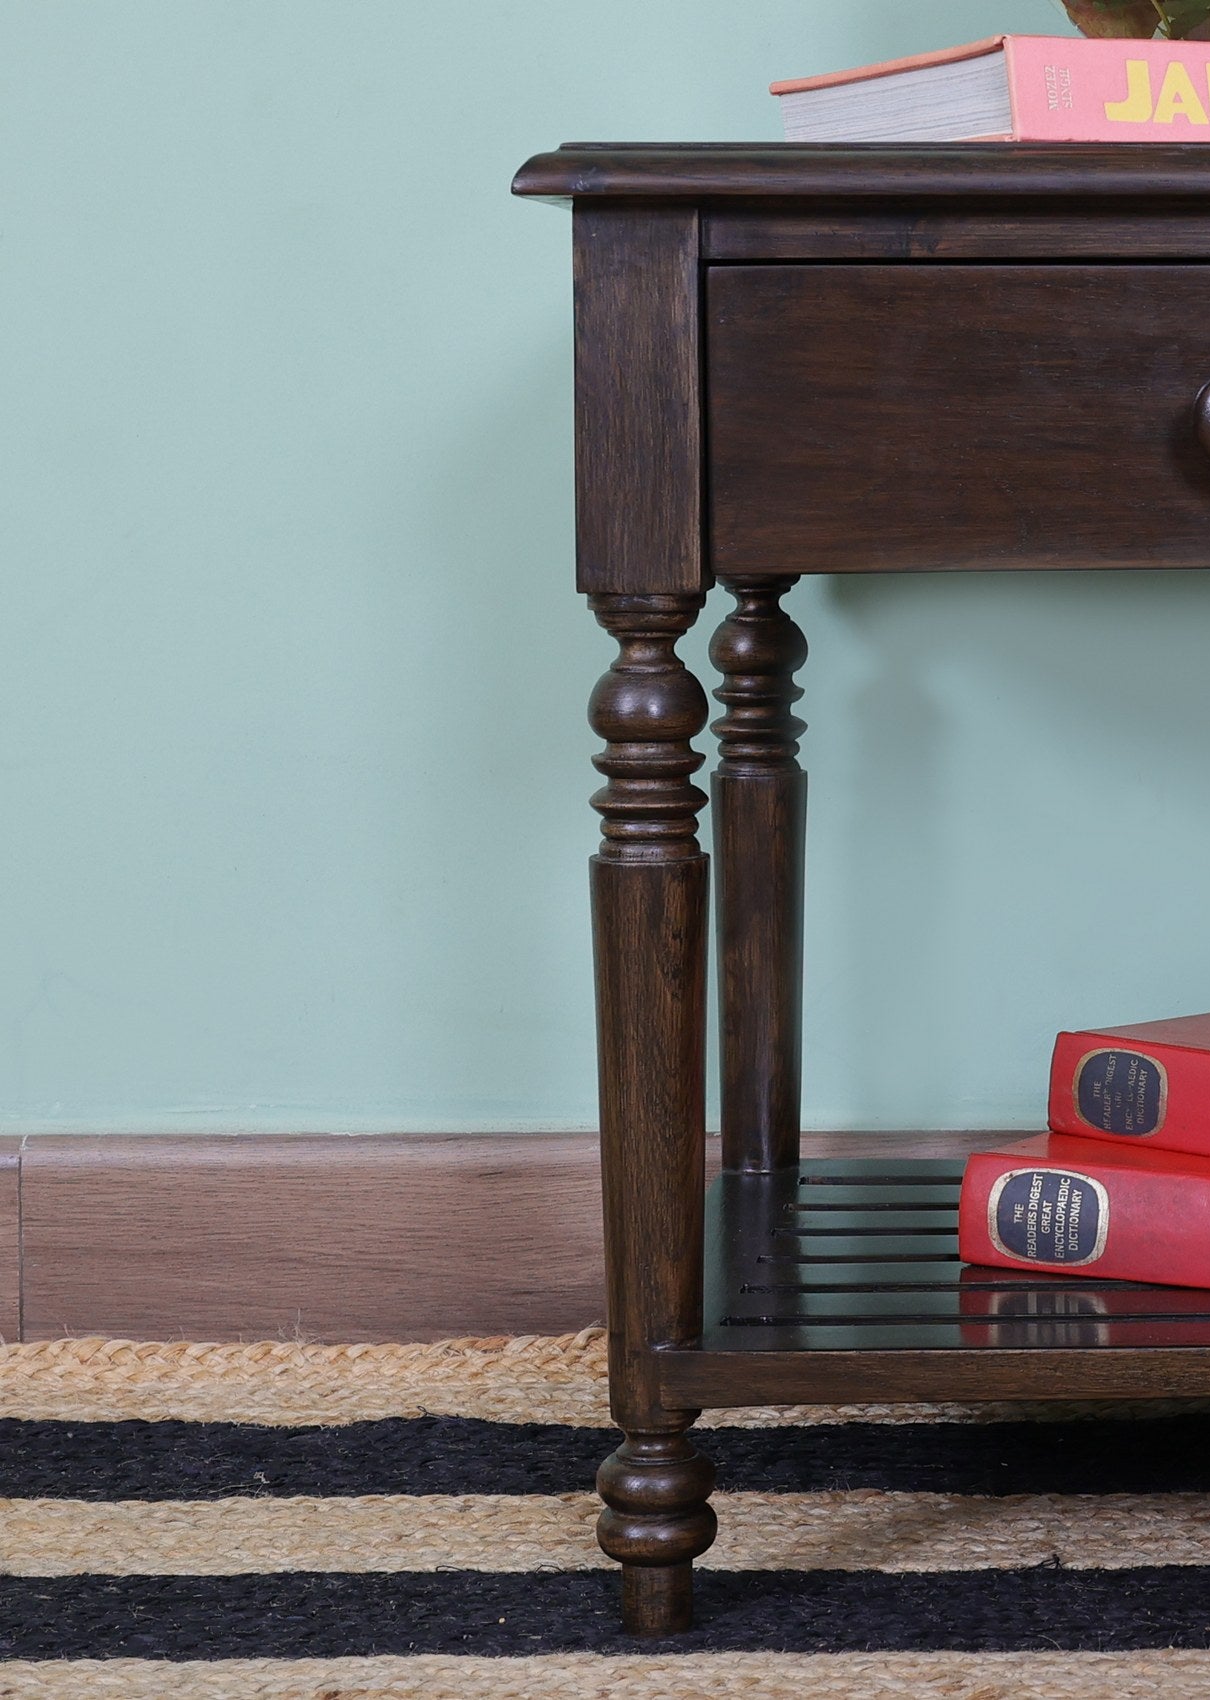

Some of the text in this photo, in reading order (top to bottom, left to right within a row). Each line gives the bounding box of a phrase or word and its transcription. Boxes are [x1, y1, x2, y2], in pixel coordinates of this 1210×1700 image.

[1029, 1173, 1044, 1211] DIGEST
[1013, 1203, 1025, 1224] THE
[1041, 1200, 1053, 1234] GREAT
[1054, 1177, 1071, 1259] ENCYCLOPAEDIC
[1068, 1189, 1083, 1251] DICTIONARY
